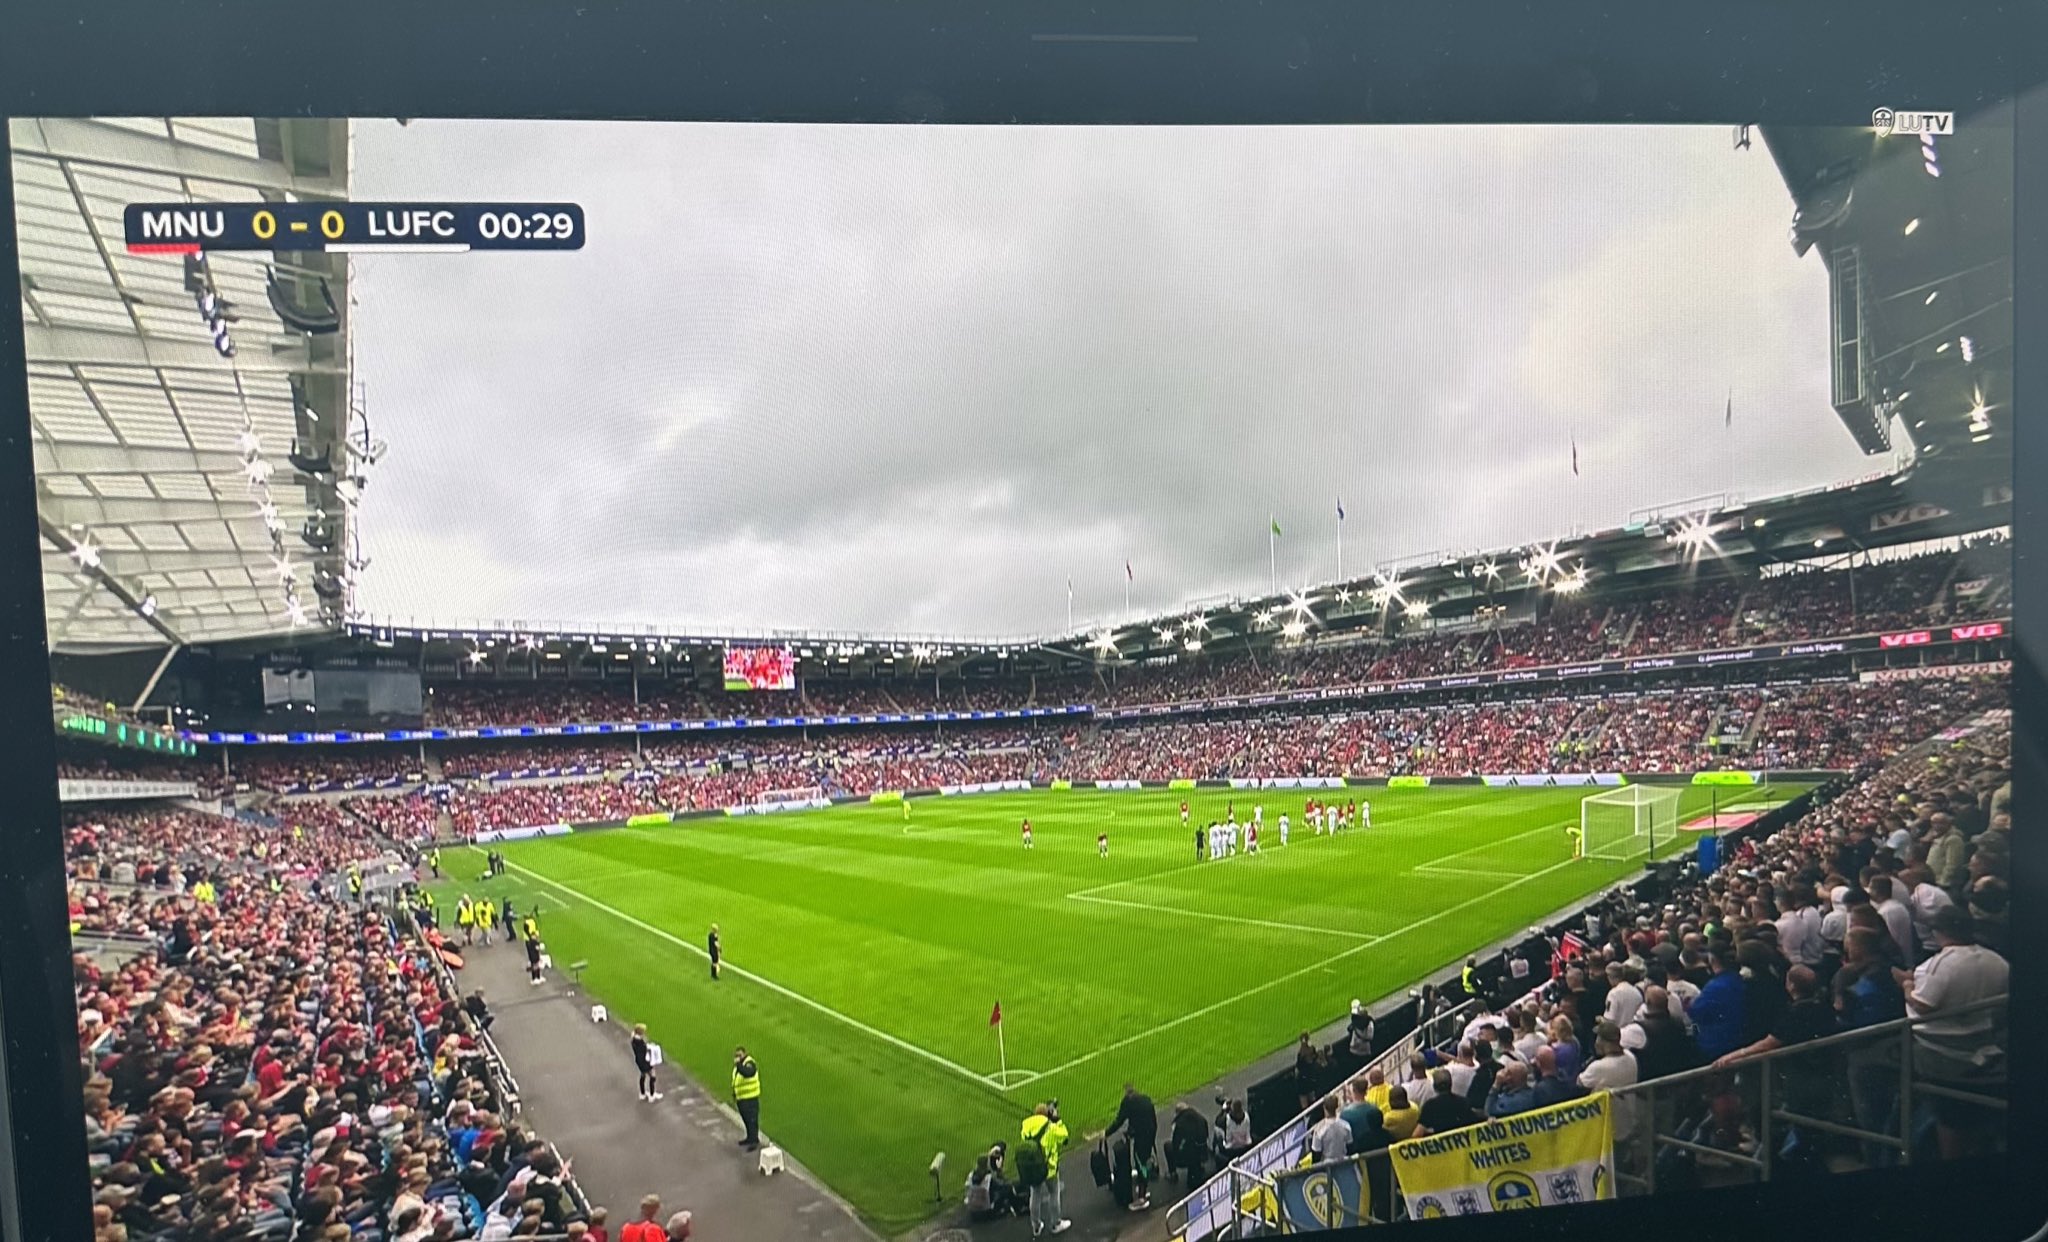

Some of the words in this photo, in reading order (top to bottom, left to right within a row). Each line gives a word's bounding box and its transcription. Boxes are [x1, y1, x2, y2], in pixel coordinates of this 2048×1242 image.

[1899, 114, 1949, 132] LUTV
[143, 210, 225, 237] MNU
[252, 210, 276, 239] 0
[321, 210, 345, 239] 0
[369, 210, 456, 237] LUFC
[478, 211, 574, 239] 00:29
[1881, 631, 1930, 646] VG
[1952, 623, 2002, 639] VG
[1400, 1129, 1472, 1161] COVENTRY
[1477, 1122, 1507, 1145] AND
[1511, 1101, 1602, 1137] NUNEATON
[1469, 1142, 1531, 1169] WHITES
